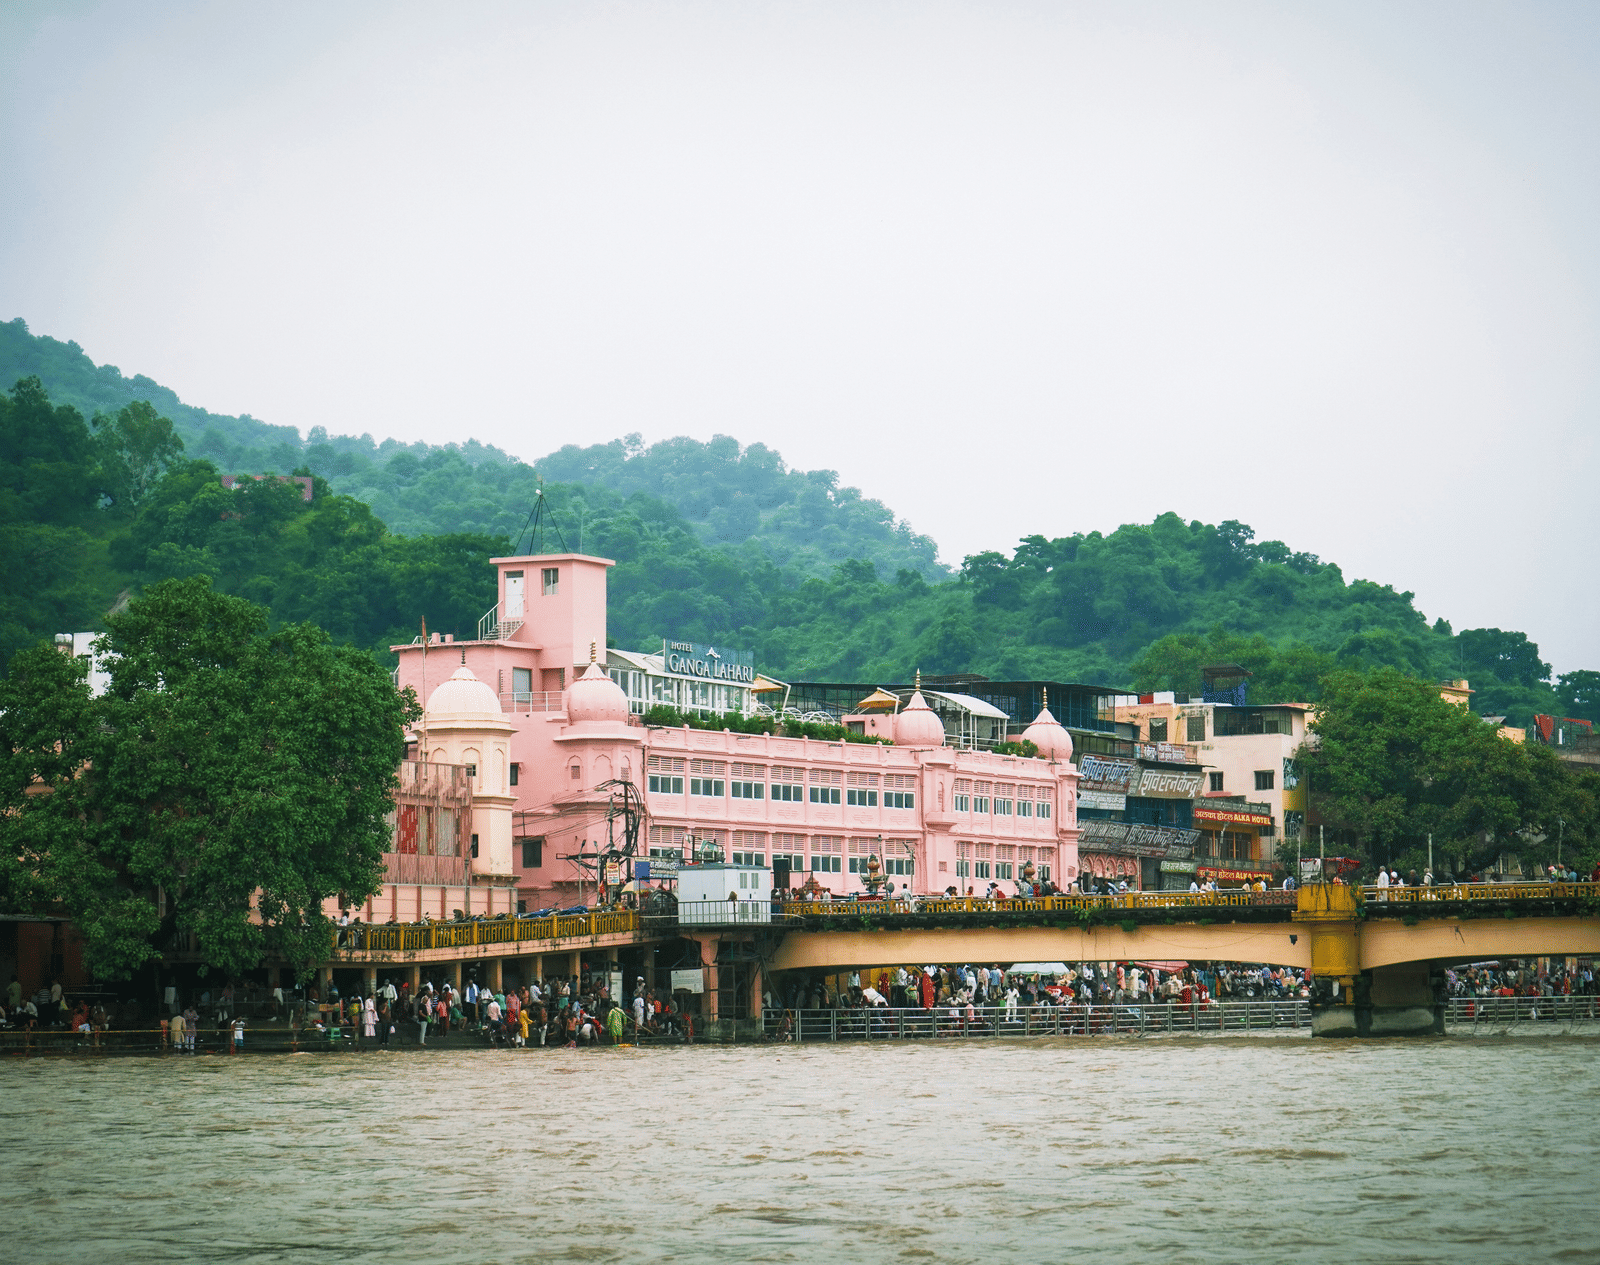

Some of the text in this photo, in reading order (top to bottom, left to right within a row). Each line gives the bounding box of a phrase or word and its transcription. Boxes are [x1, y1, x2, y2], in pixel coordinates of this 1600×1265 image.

[671, 641, 693, 652] HOTEL
[669, 654, 753, 682] GANGA LAHARI
[1196, 811, 1233, 821] अलका होटल
[1234, 814, 1271, 825] ALKA HOTEL
[1218, 869, 1234, 879] होटल
[1235, 871, 1252, 880] ALKA
